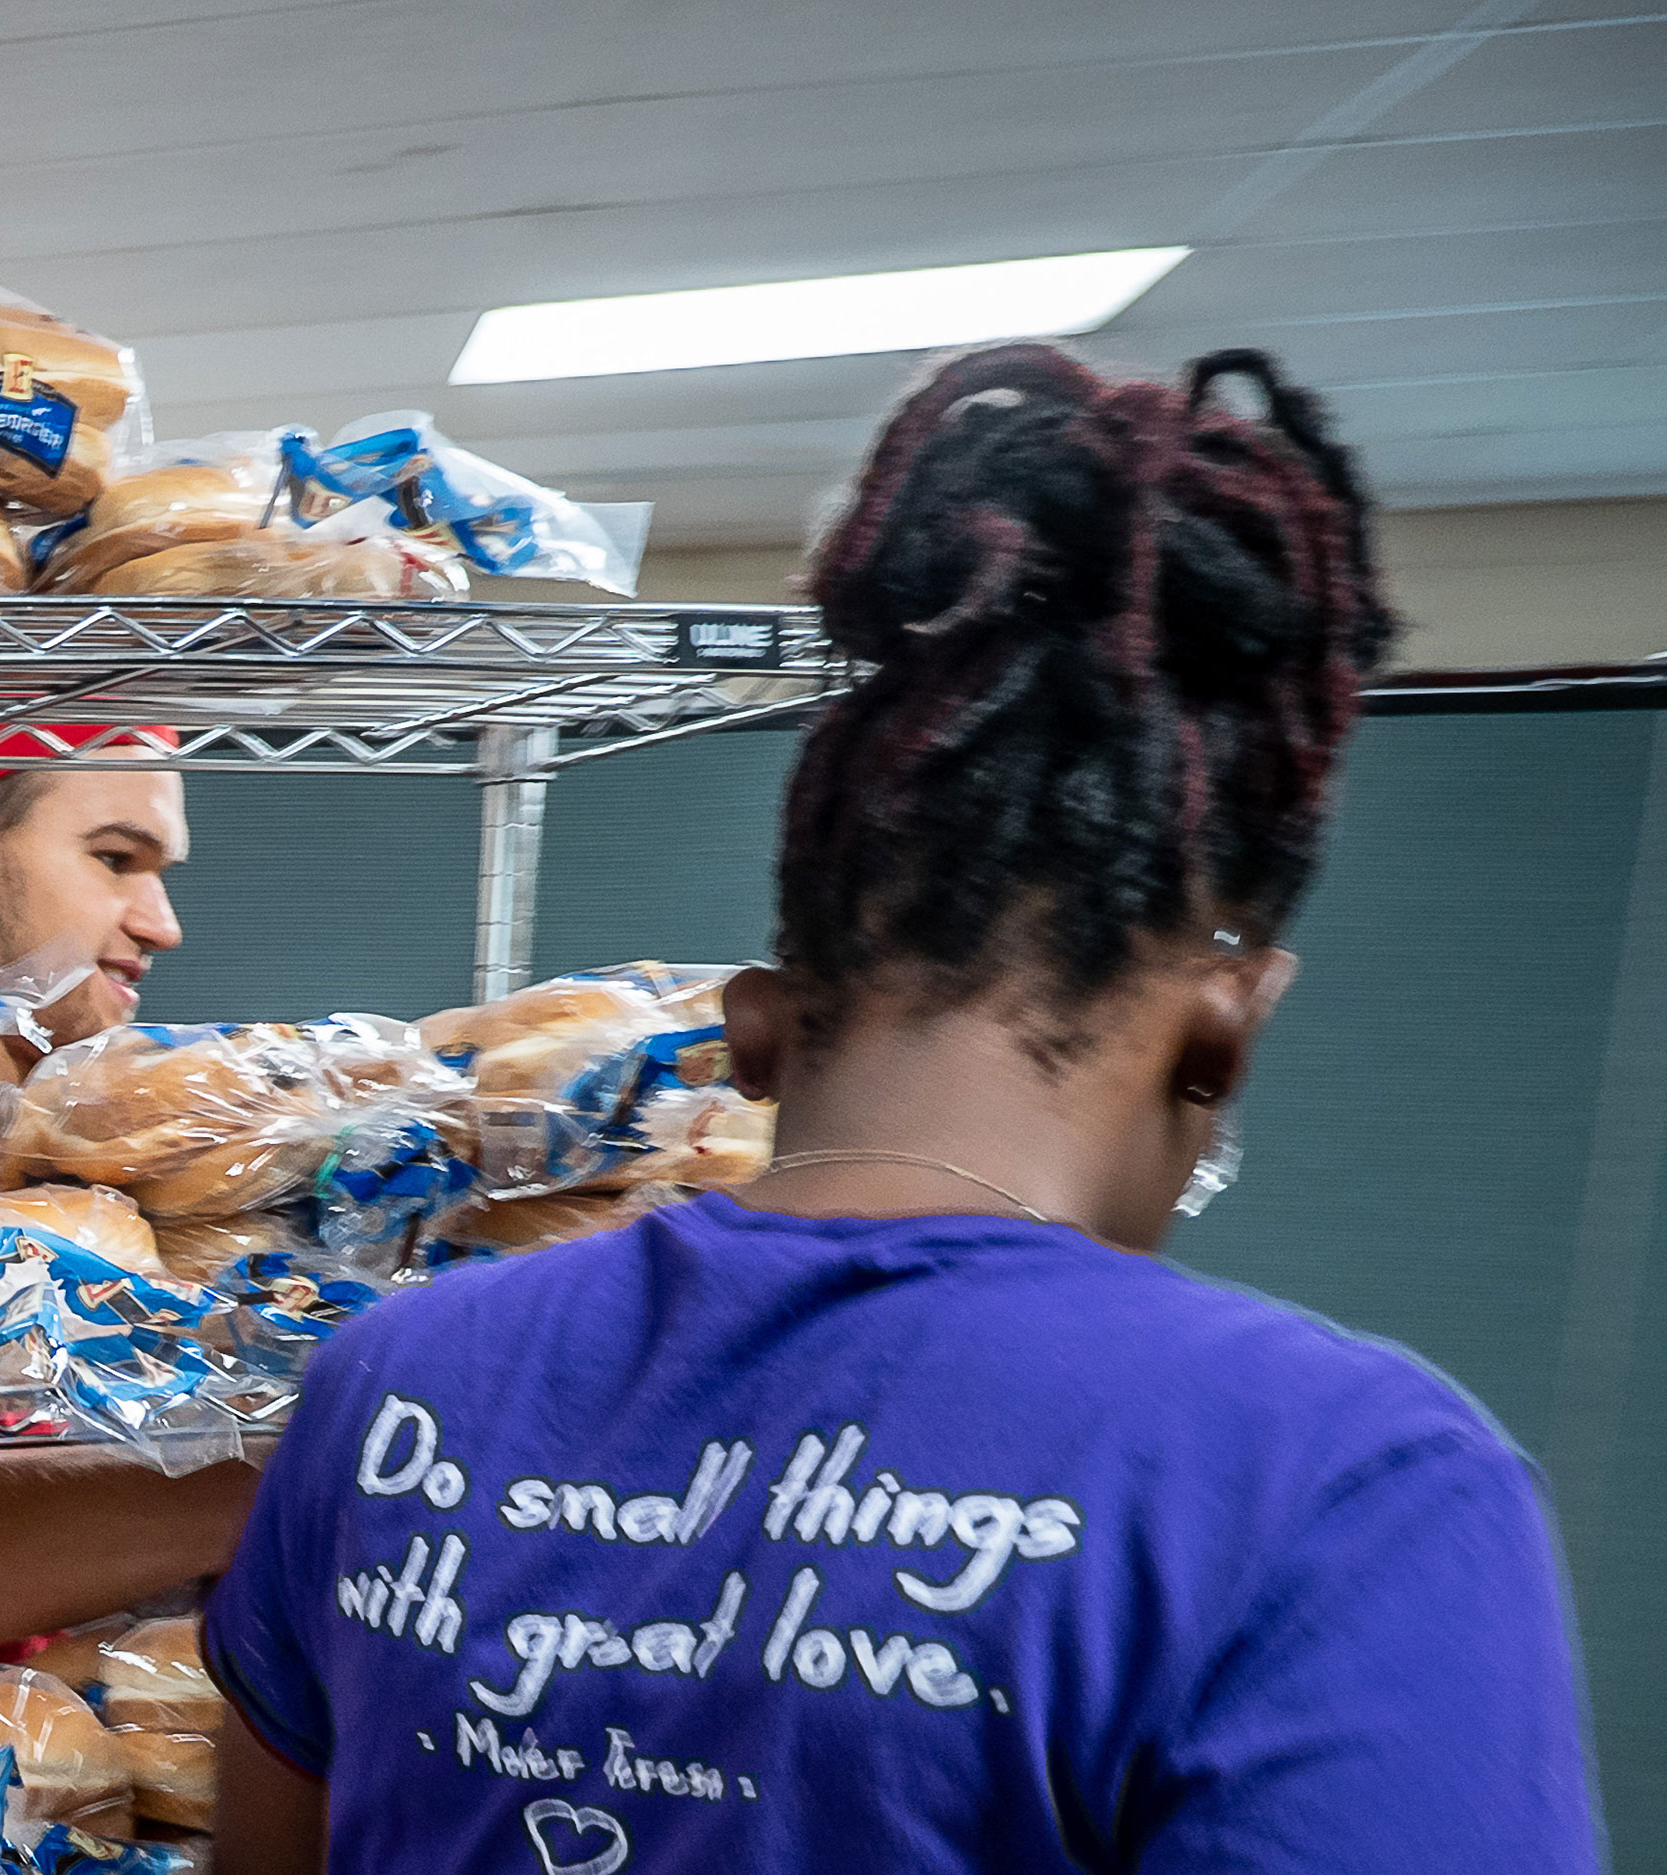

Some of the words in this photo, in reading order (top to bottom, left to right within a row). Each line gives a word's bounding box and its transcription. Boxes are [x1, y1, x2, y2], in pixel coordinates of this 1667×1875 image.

[357, 1394, 466, 1509] Do
[500, 1439, 752, 1546] small
[763, 1423, 1083, 1612] things
[337, 1535, 463, 1655] with
[470, 1571, 748, 1716] great
